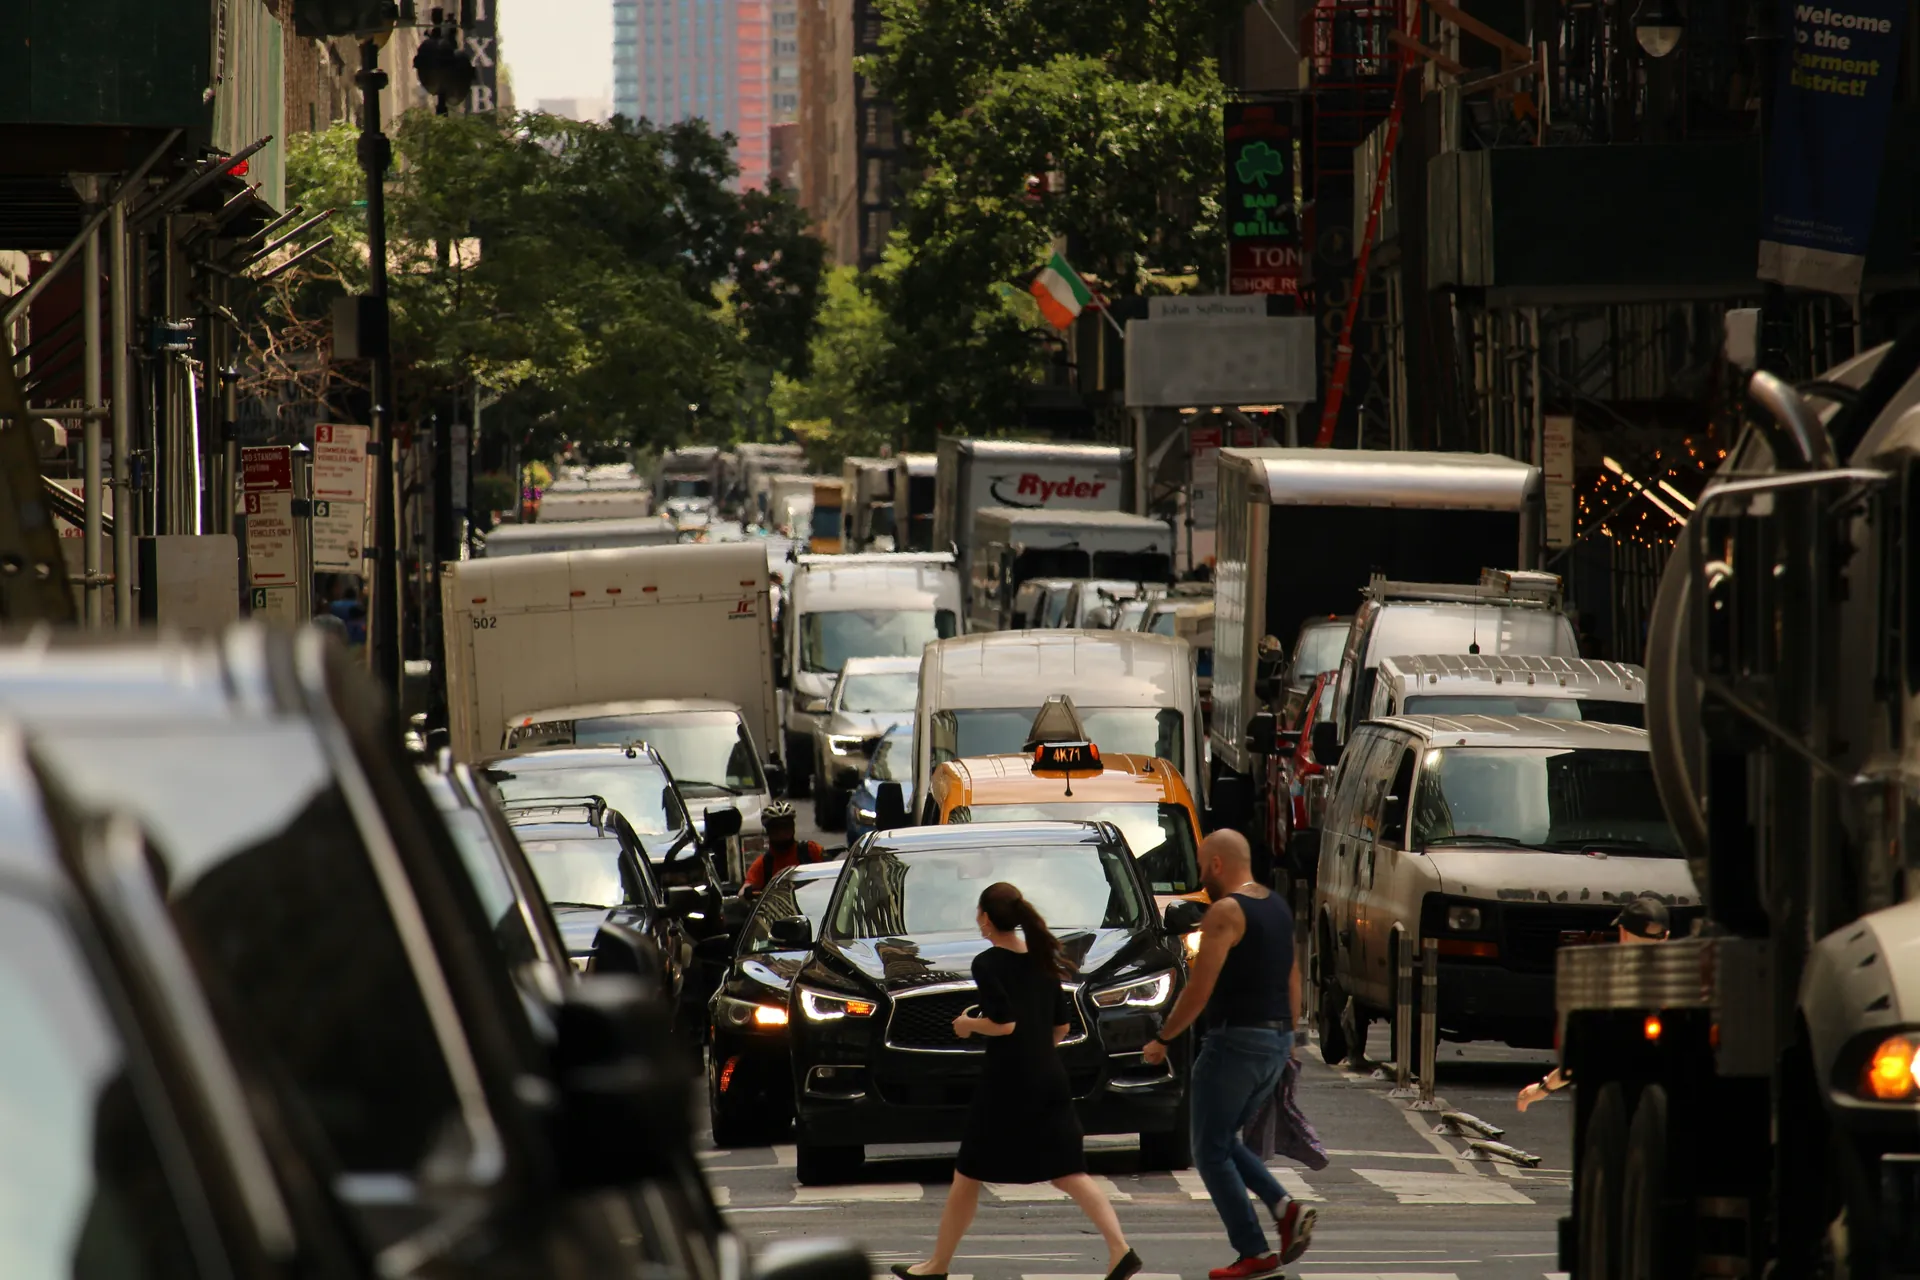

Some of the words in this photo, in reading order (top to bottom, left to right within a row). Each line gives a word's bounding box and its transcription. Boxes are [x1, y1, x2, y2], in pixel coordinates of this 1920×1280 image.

[1793, 3, 1892, 34] Welcome
[1813, 29, 1851, 50] the
[1790, 66, 1868, 98] Dstrict!
[1242, 193, 1279, 208] BAR
[1232, 221, 1290, 237] GRILL
[1231, 277, 1277, 292] SHOE
[320, 427, 329, 441] 3
[243, 453, 253, 462] NO
[254, 452, 283, 462] STANDING
[1017, 472, 1106, 503] Ryder
[249, 494, 258, 513] 3
[317, 502, 327, 517] 6
[255, 590, 265, 608] 6
[473, 616, 497, 630] 502
[1053, 747, 1081, 762] 4K71
